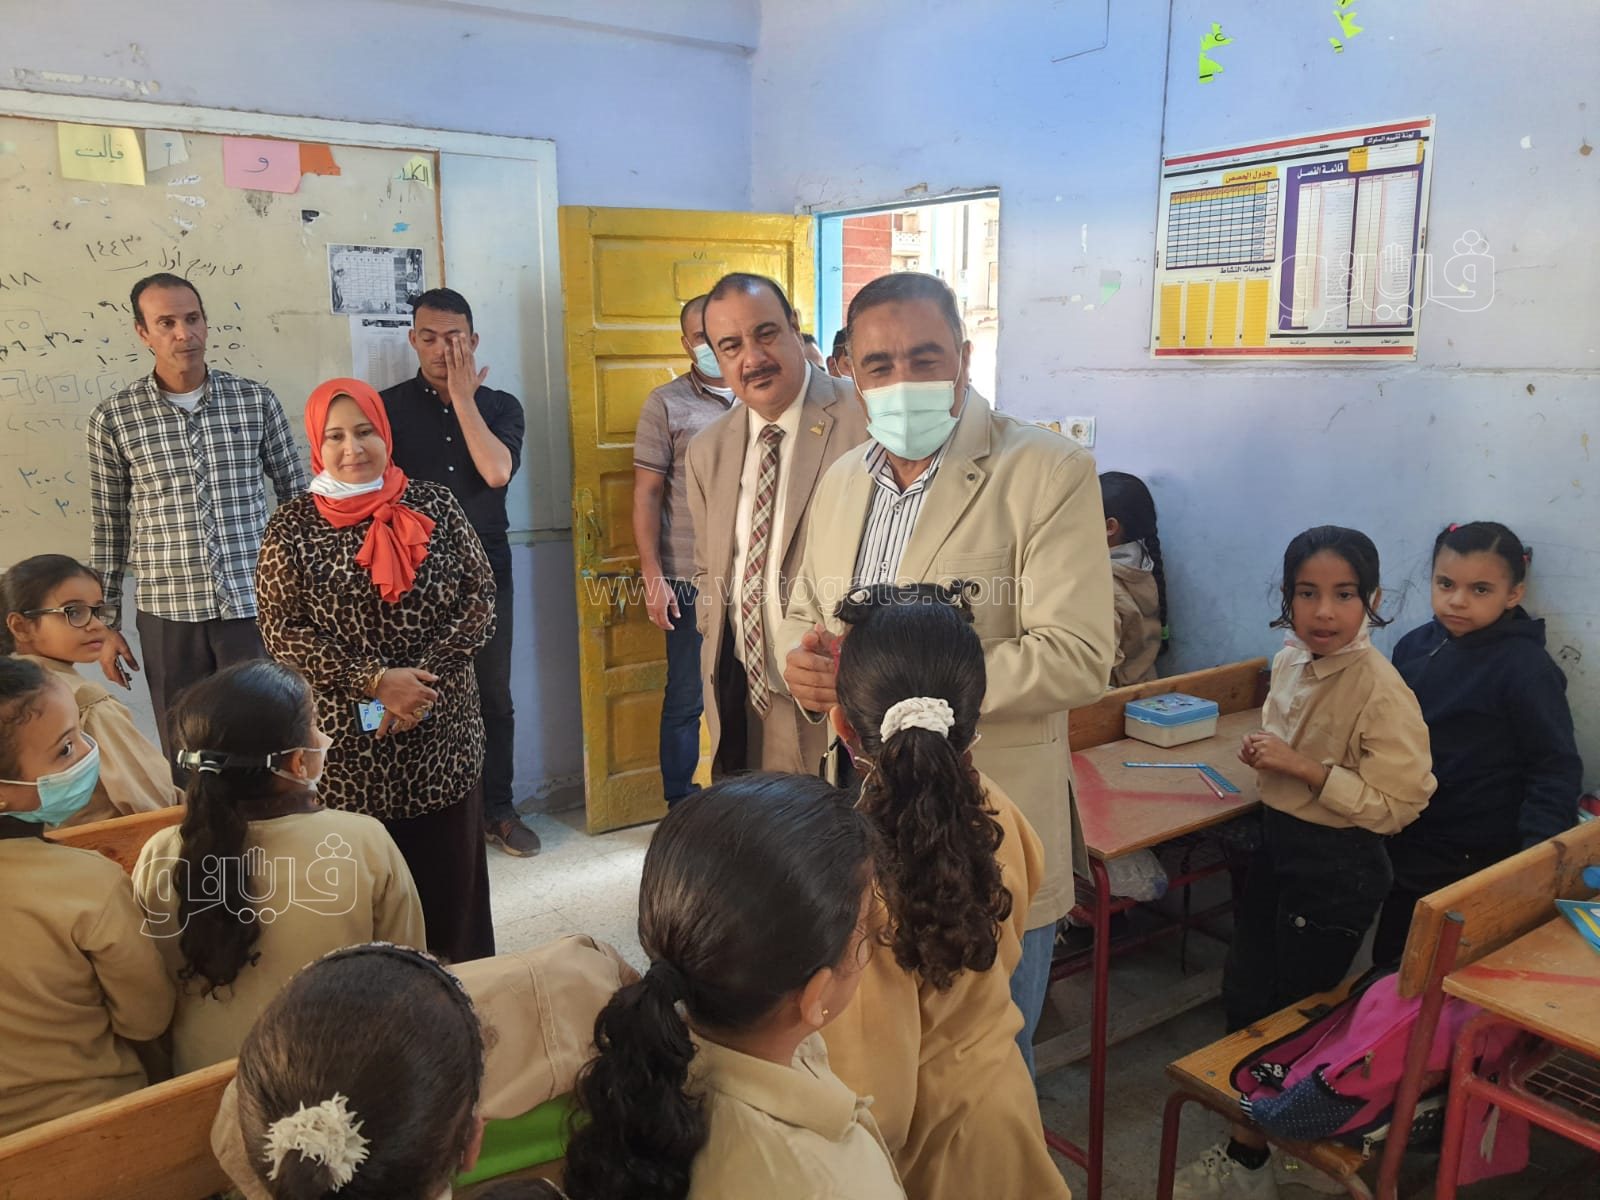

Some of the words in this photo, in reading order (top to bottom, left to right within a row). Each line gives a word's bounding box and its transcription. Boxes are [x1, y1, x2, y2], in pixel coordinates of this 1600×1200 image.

[1297, 166, 1321, 180] الفصل
[1323, 162, 1344, 174] قائمة
[1252, 170, 1272, 180] جدول
[1219, 265, 1242, 275] النشاط
[1242, 265, 1272, 274] مجموعات
